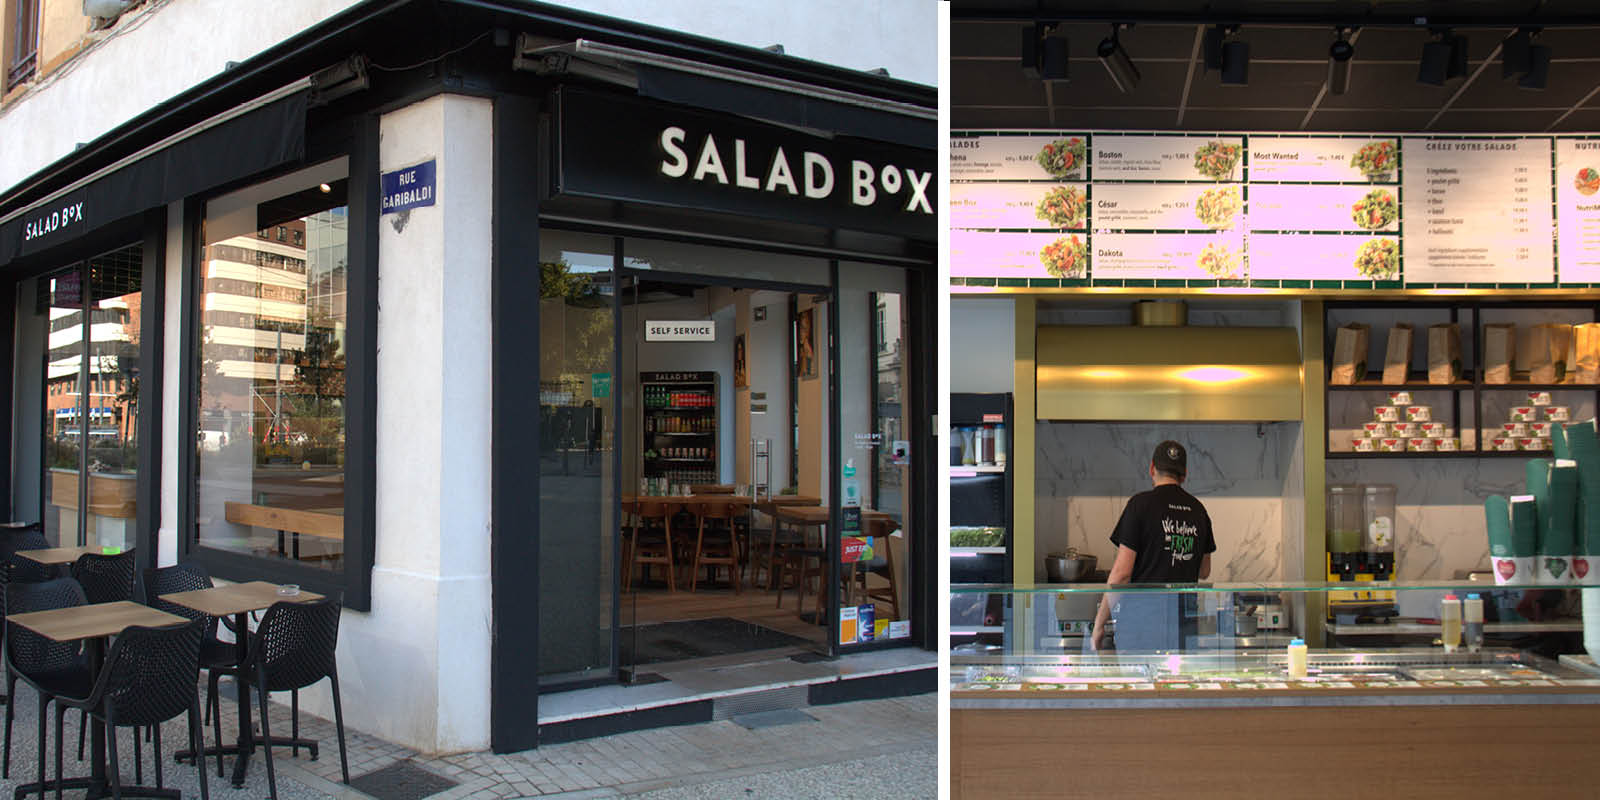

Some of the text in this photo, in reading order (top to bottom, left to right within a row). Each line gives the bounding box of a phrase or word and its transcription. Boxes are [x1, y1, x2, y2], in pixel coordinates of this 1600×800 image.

[1426, 142, 1452, 150] CRÉEZ
[1098, 151, 1122, 159] Boston
[1254, 152, 1299, 160] Most Wanted
[661, 126, 835, 199] SALAD
[399, 171, 416, 186] RUE
[383, 186, 431, 208] GARIBALDI
[1098, 200, 1117, 208] César
[26, 212, 59, 240] SALAD
[1098, 249, 1123, 257] Dakota
[651, 327, 710, 335] SELF SERVICE
[656, 373, 680, 381] SALAD
[1162, 517, 1198, 536] We believe
